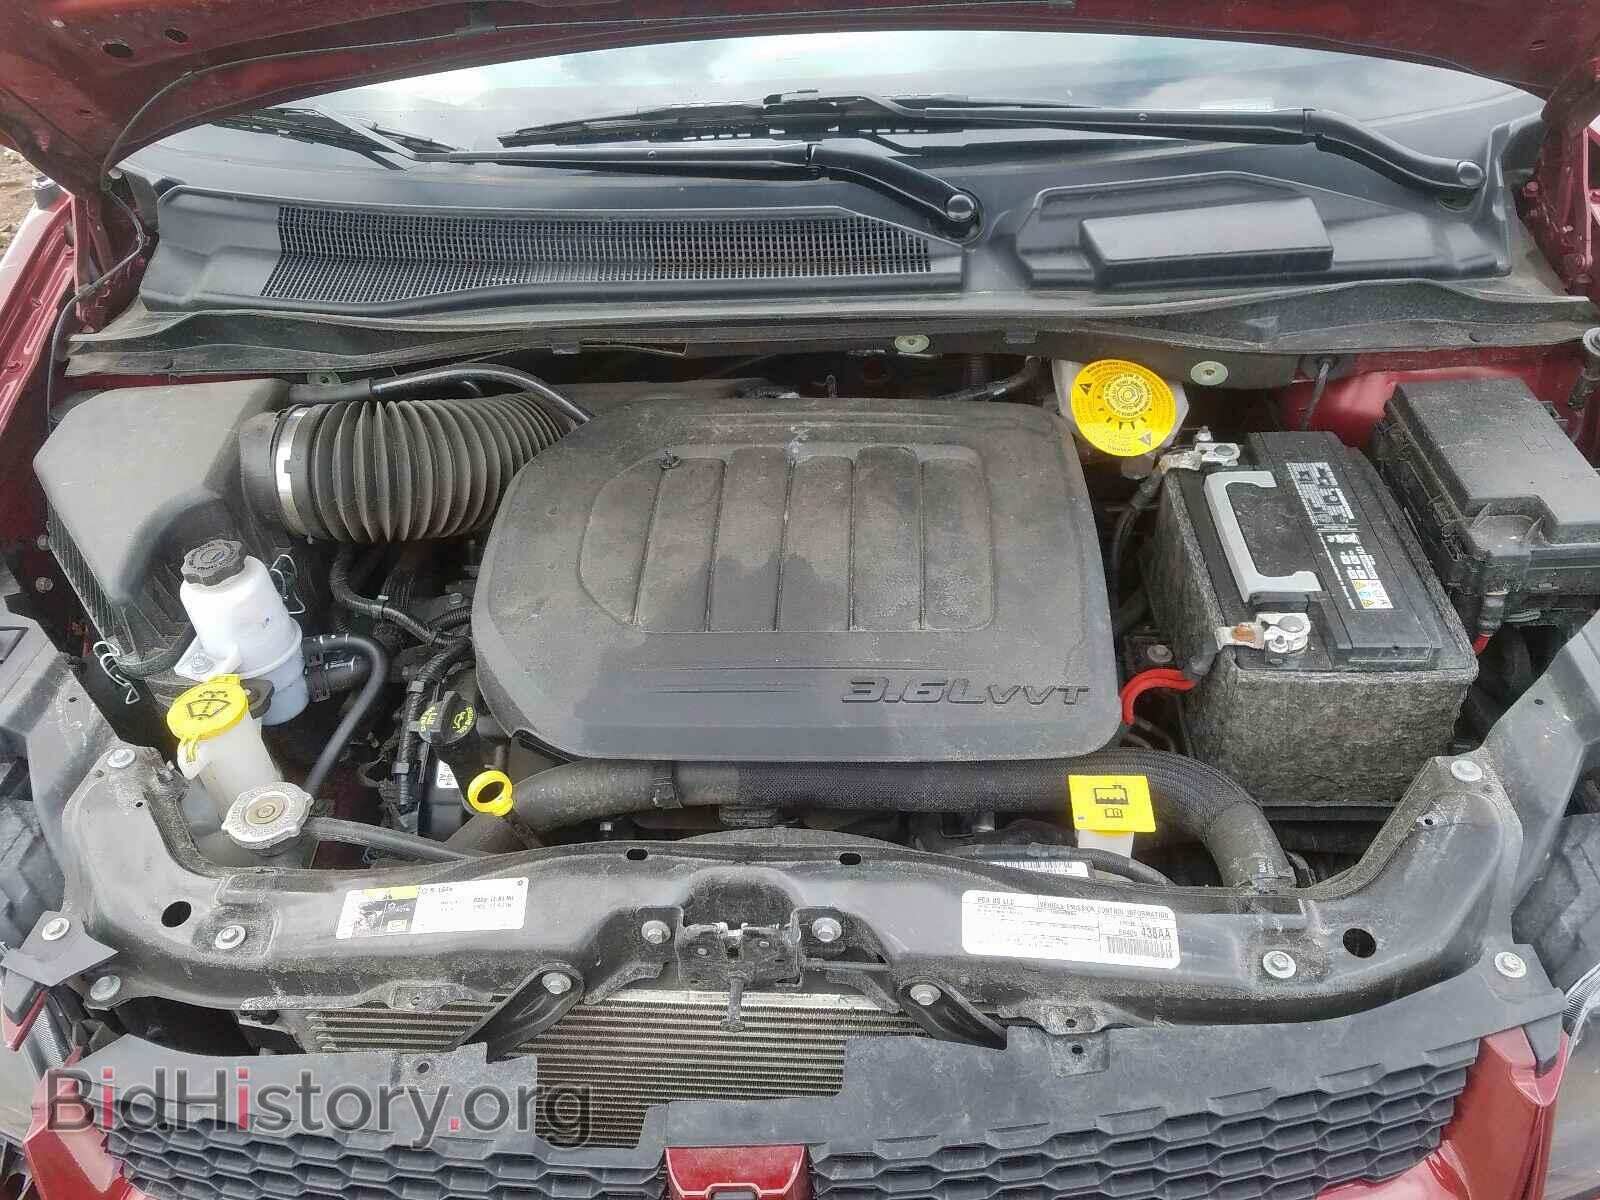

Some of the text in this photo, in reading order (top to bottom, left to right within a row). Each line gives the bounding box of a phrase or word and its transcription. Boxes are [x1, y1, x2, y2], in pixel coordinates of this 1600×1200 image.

[1066, 903, 1095, 912] EMISSION
[1097, 906, 1124, 915] CONTROL
[1127, 909, 1169, 919] INFORMATION
